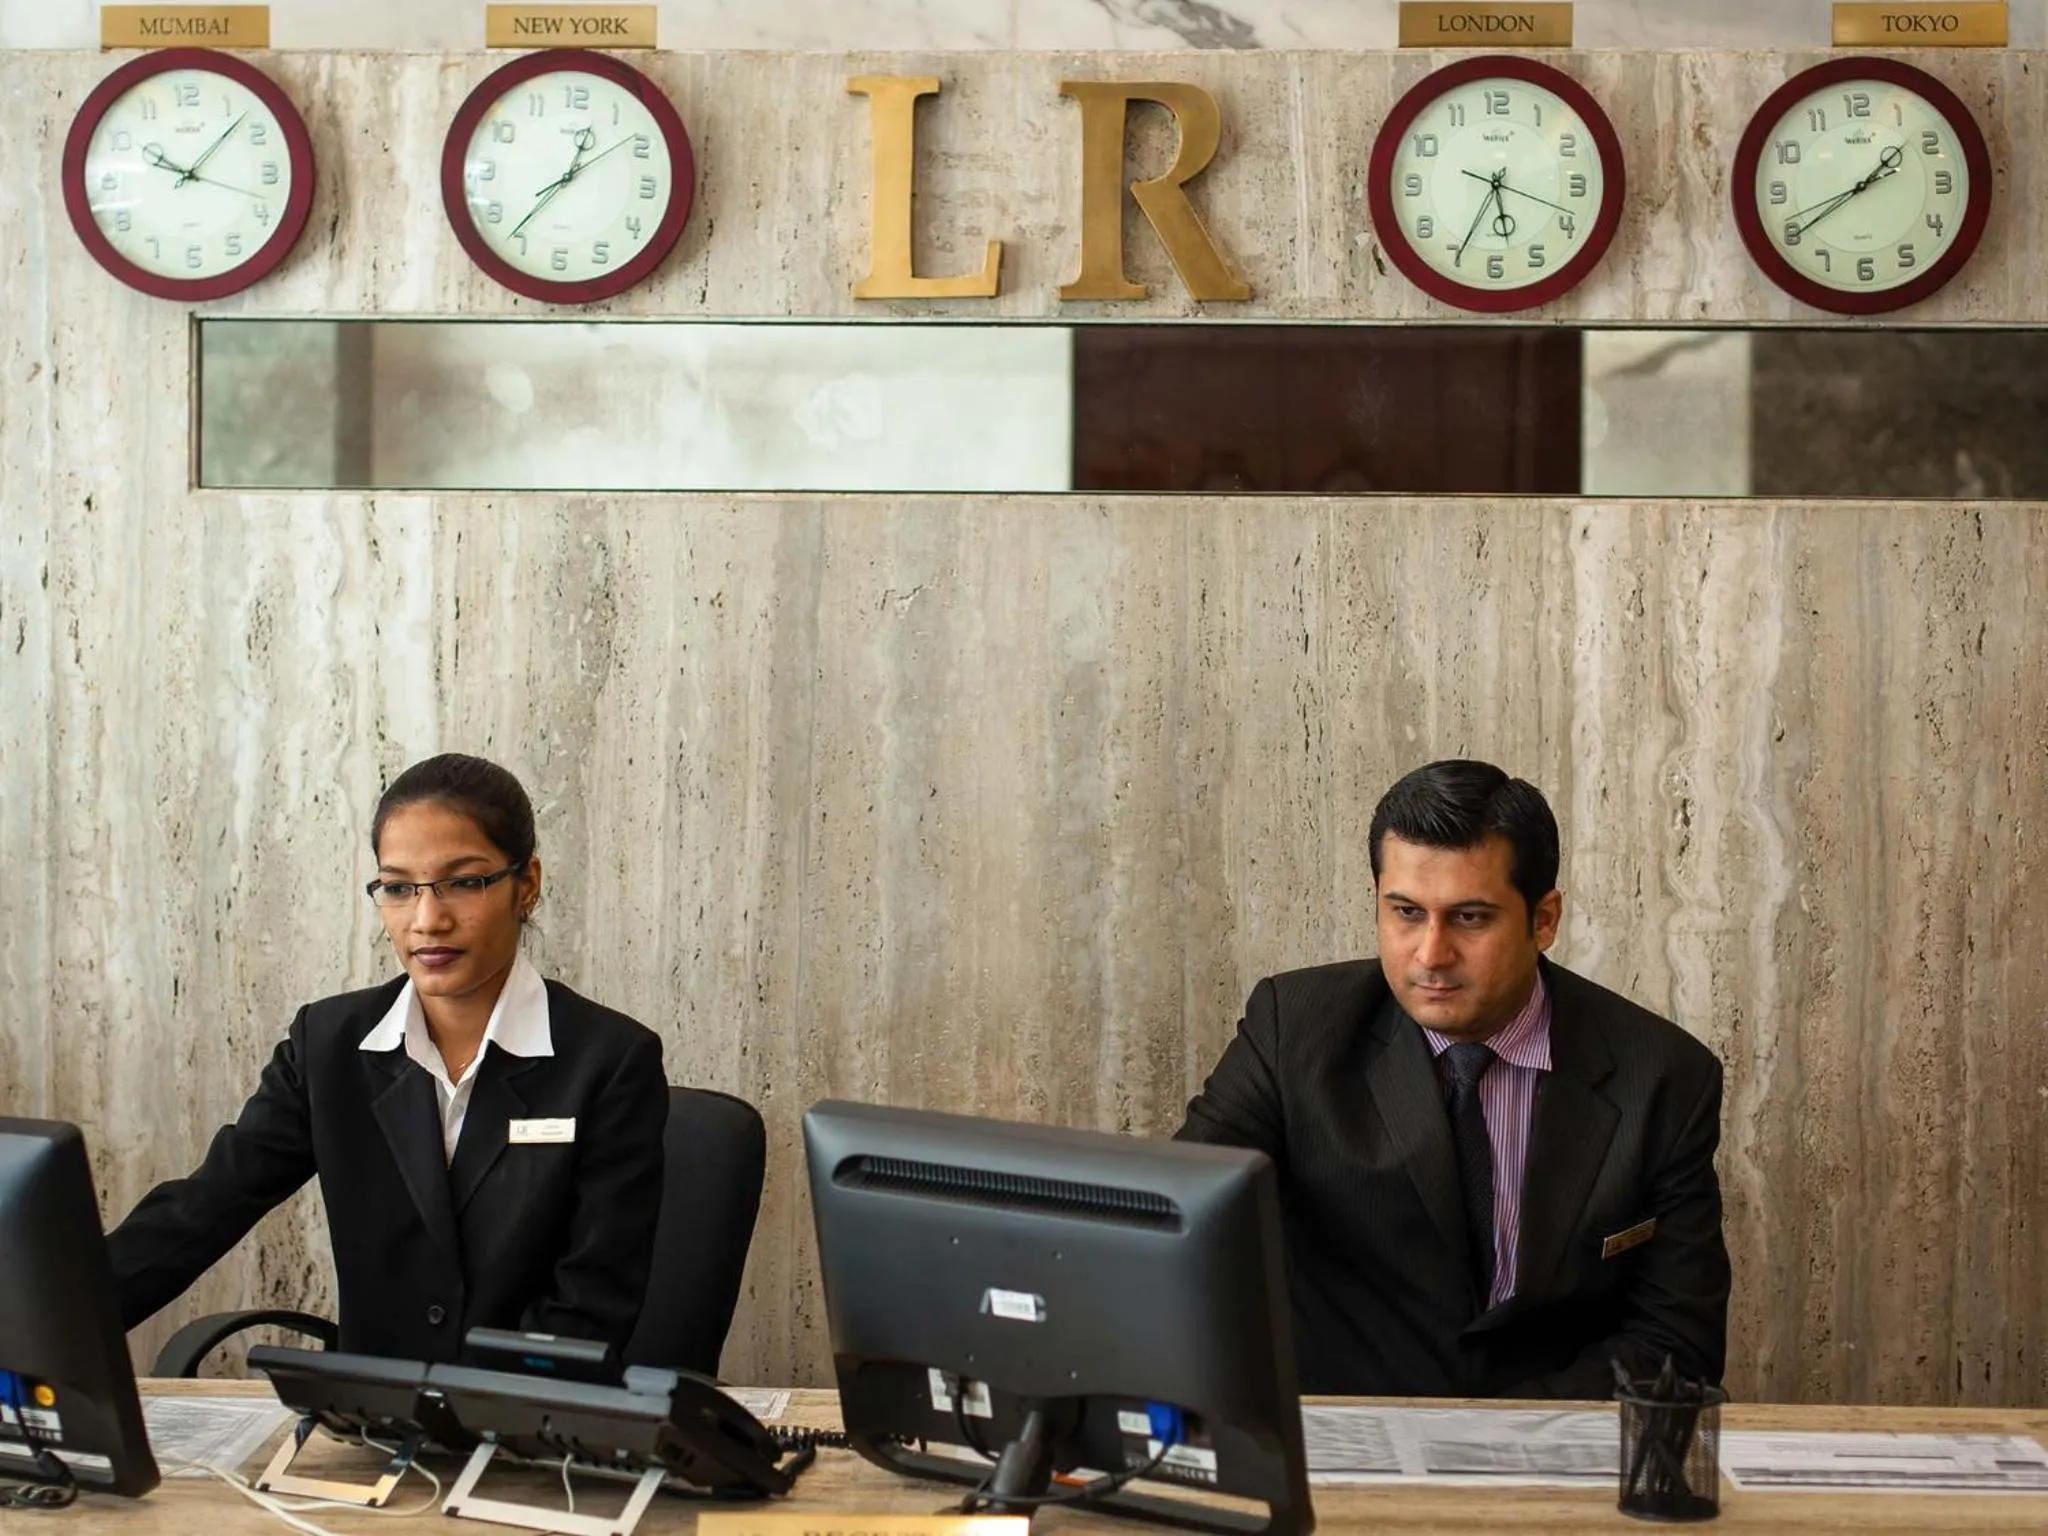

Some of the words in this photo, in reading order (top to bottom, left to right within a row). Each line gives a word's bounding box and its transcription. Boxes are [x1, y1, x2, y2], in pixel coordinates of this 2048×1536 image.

[139, 17, 229, 35] MUMBAI
[513, 17, 563, 34] NEW
[569, 17, 628, 34] YORK
[1438, 15, 1534, 32] LONDON
[1881, 15, 1958, 32] TOKYO
[175, 84, 199, 107] 12
[529, 93, 544, 117] 11
[565, 86, 589, 110] 12
[1484, 91, 1510, 115] 12
[1843, 94, 1870, 118] 12
[141, 98, 157, 120] 11
[612, 102, 619, 126] 1
[1448, 104, 1465, 126] 11
[1533, 103, 1542, 127] 1
[1808, 108, 1826, 132] 11
[1893, 103, 1902, 126] 1
[250, 124, 266, 146] 2
[492, 120, 514, 144] 10
[1922, 131, 1939, 155] 2
[635, 133, 650, 159] 2
[1413, 134, 1438, 157] 10
[1559, 134, 1576, 157] 2
[1775, 141, 1800, 164] 10
[262, 161, 278, 185] 3
[1405, 173, 1422, 197] 9
[1934, 171, 1952, 194] 3
[640, 175, 656, 199] 3
[847, 76, 1251, 300] LR
[1570, 175, 1586, 197] 3
[1770, 181, 1787, 205] 9
[115, 210, 131, 233] 8
[254, 204, 269, 227] 4
[1416, 215, 1433, 238] 8
[1559, 215, 1575, 239] 4
[1927, 213, 1943, 237] 4
[626, 216, 641, 240] 4
[1784, 222, 1801, 246] 8
[145, 237, 160, 259] 7
[225, 233, 242, 257] 5
[513, 232, 527, 256] 7
[592, 241, 609, 265] 5
[1528, 244, 1545, 267] 5
[1899, 243, 1915, 267] 5
[186, 245, 202, 269] 6
[552, 247, 568, 271] 6
[1487, 255, 1504, 279] 6
[1815, 249, 1831, 272] 7
[1857, 257, 1874, 281] 6
